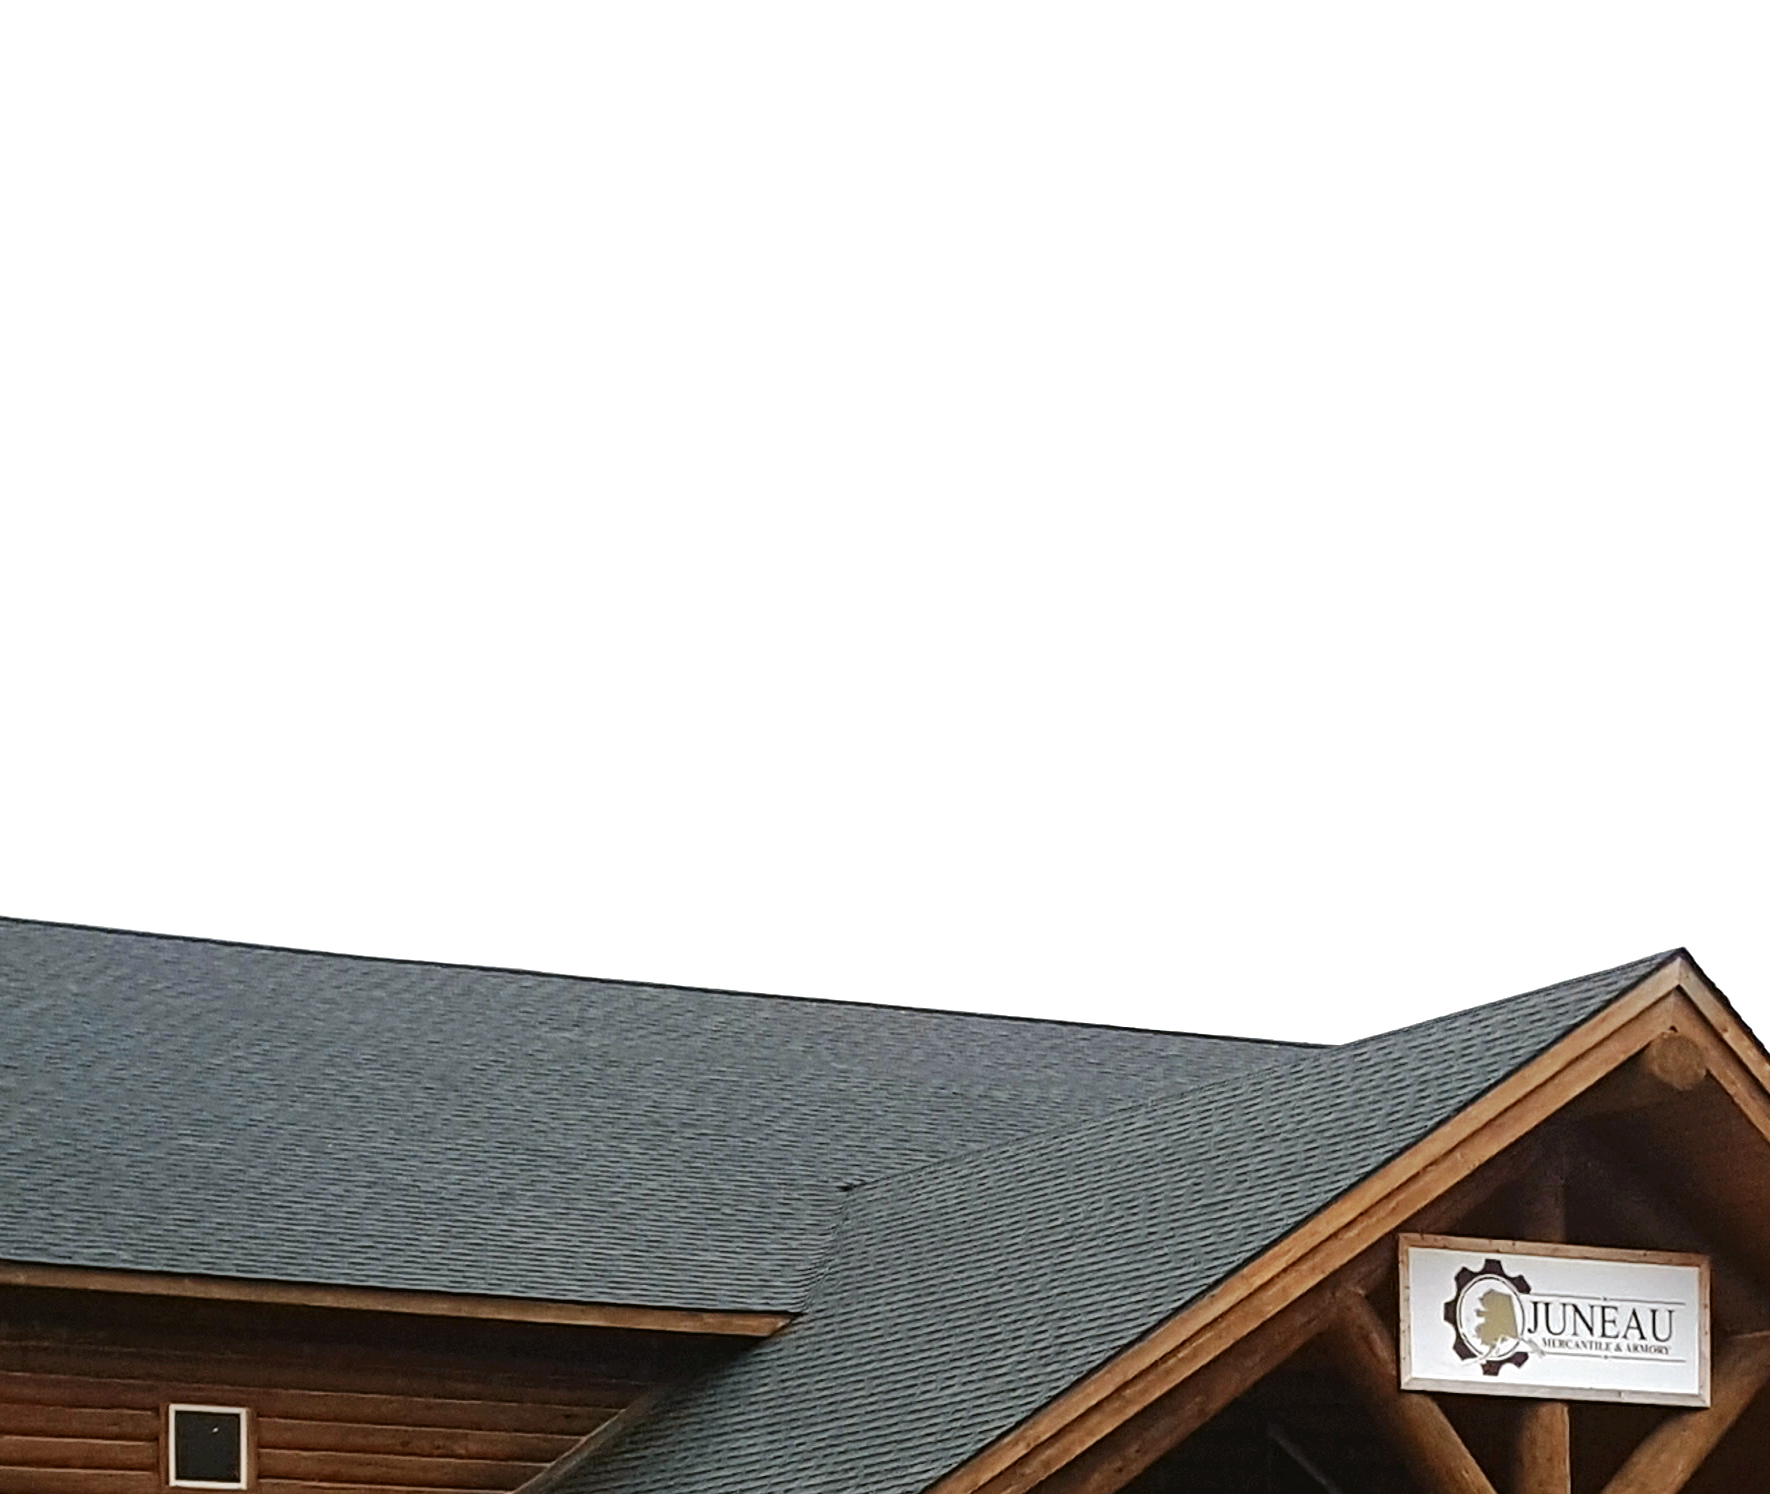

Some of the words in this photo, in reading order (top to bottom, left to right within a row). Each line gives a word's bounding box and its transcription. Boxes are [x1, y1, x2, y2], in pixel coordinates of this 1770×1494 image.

[1527, 1300, 1676, 1343] JUNEAU
[1542, 1337, 1613, 1352] MERCANTILE
[1614, 1342, 1623, 1353] &
[1625, 1343, 1671, 1356] ARMORY
